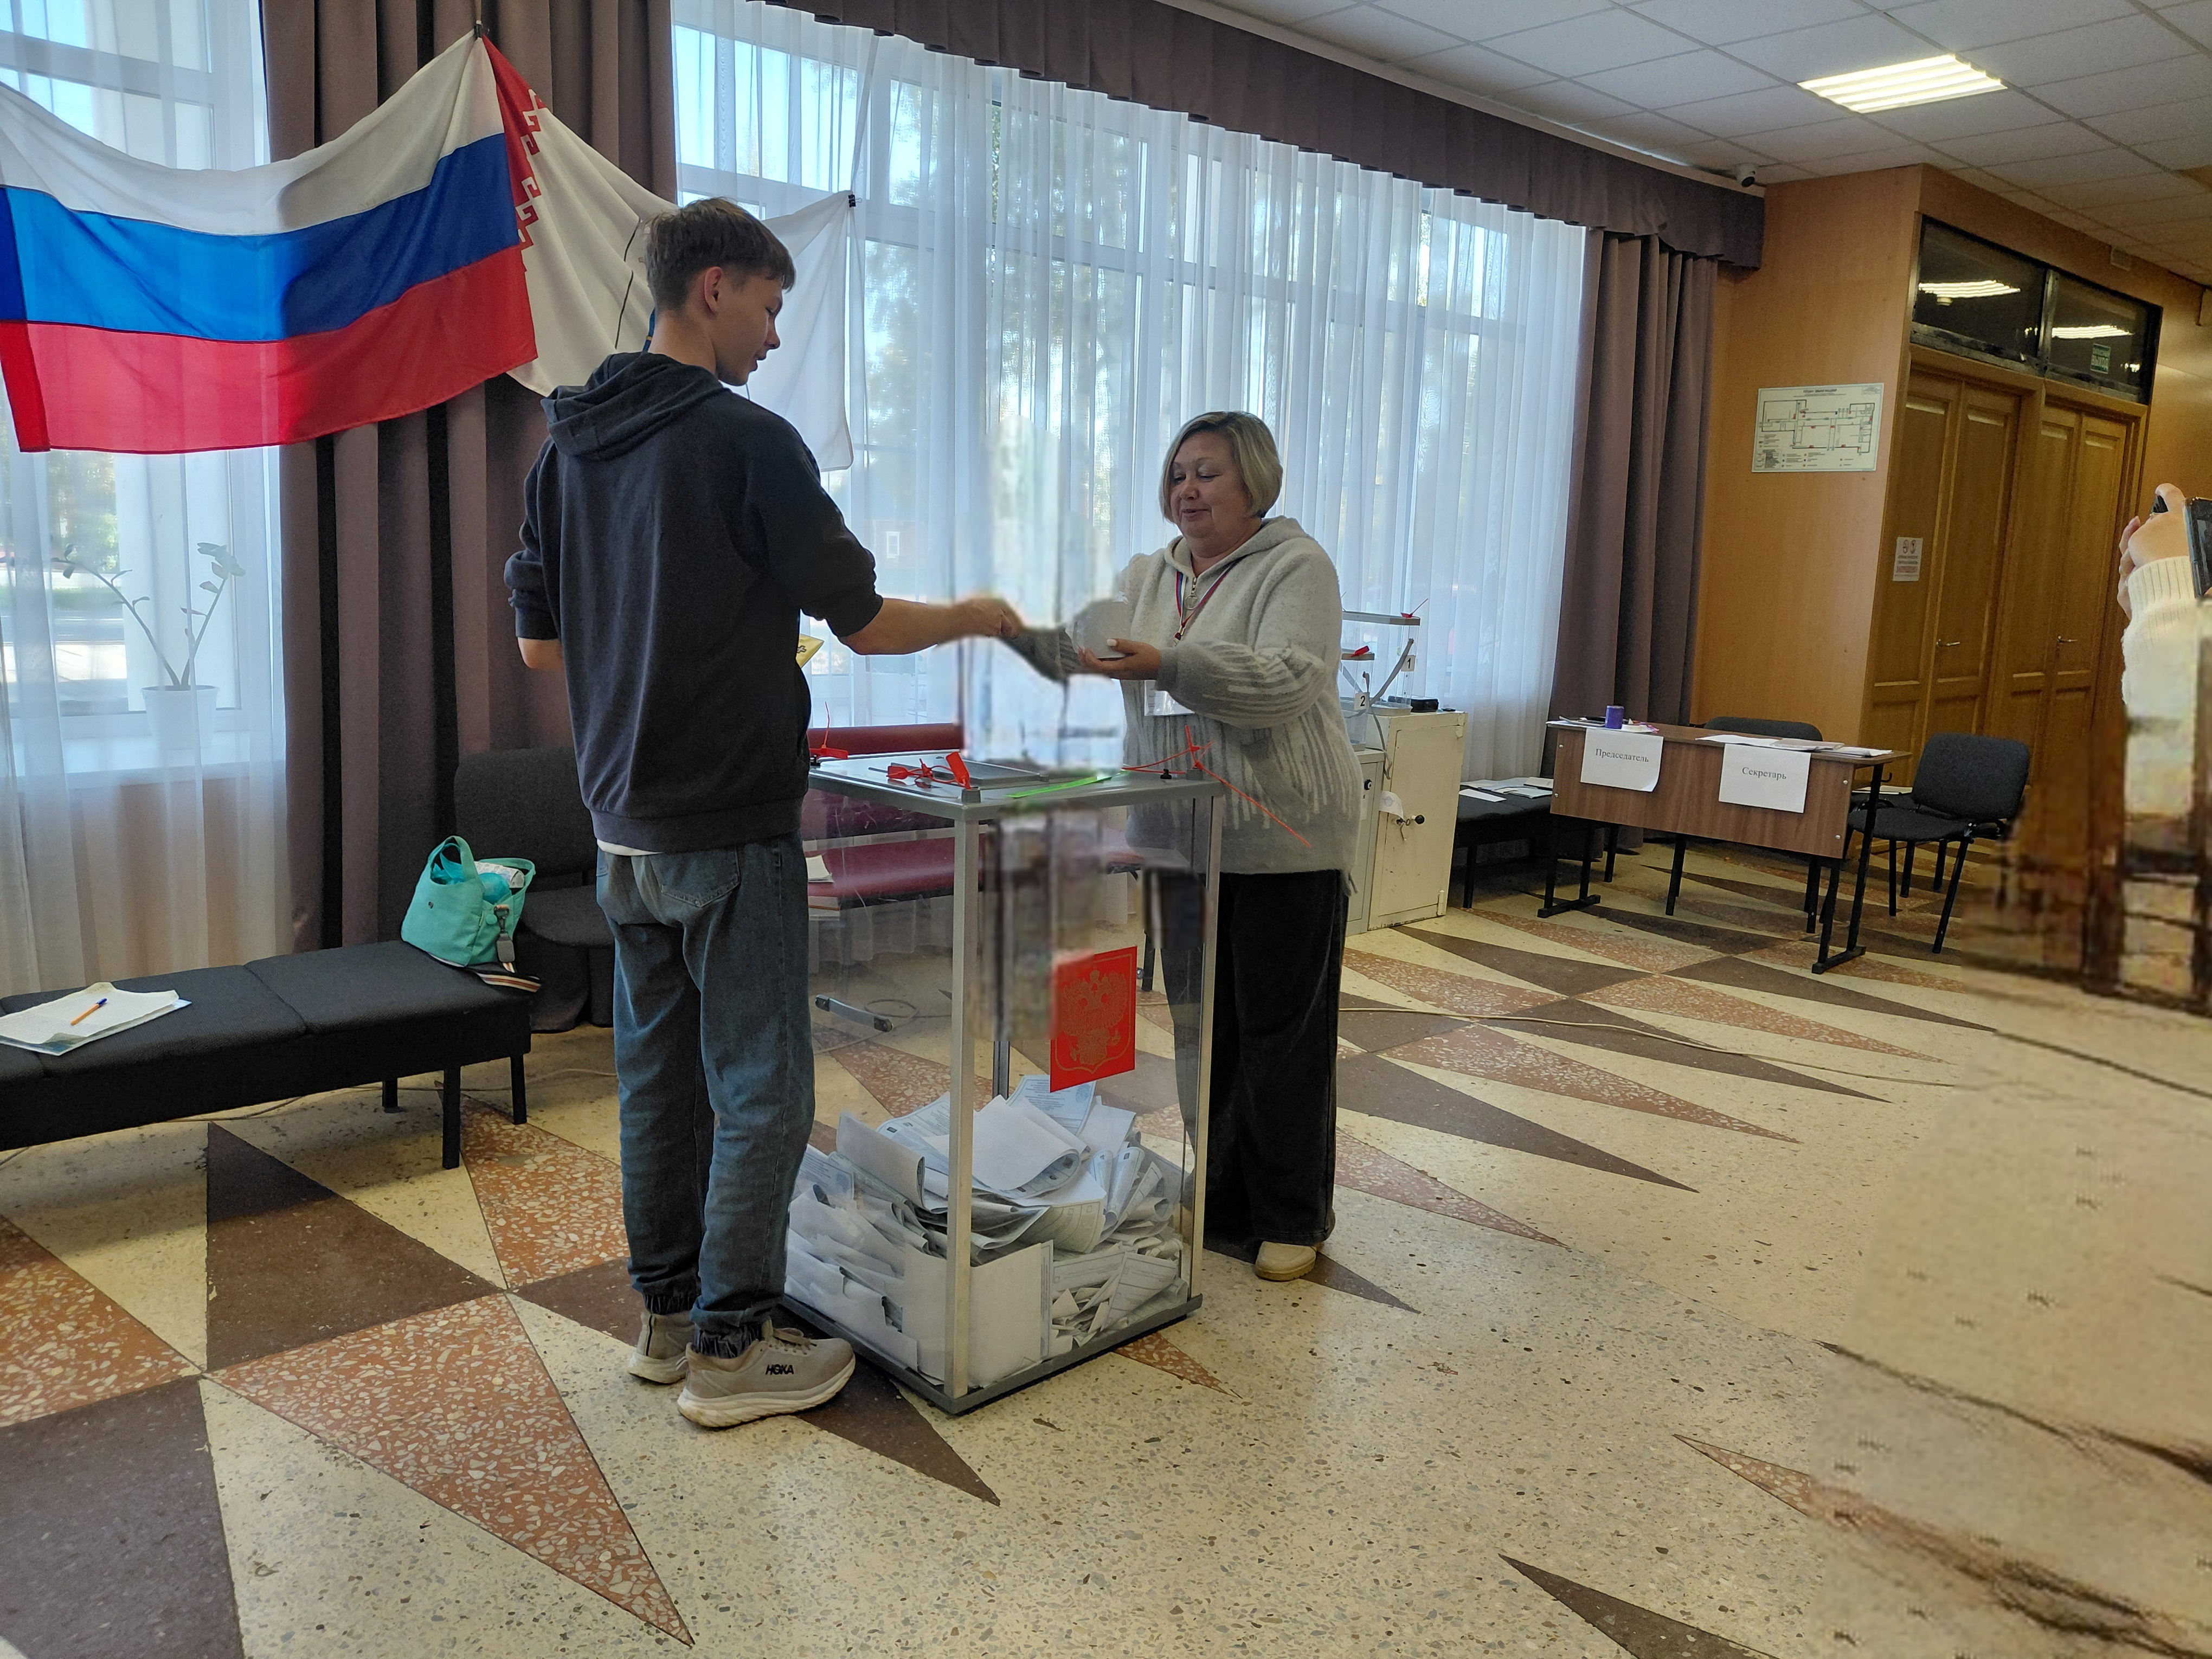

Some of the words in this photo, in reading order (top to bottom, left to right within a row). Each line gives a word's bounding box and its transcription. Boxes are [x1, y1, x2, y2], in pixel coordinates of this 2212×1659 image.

[1407, 658, 1411, 669] 1
[1360, 695, 1366, 707] 2
[1596, 748, 1649, 762] Председатель
[1742, 767, 1787, 781] Секретарь
[765, 1364, 794, 1375] HOKA
